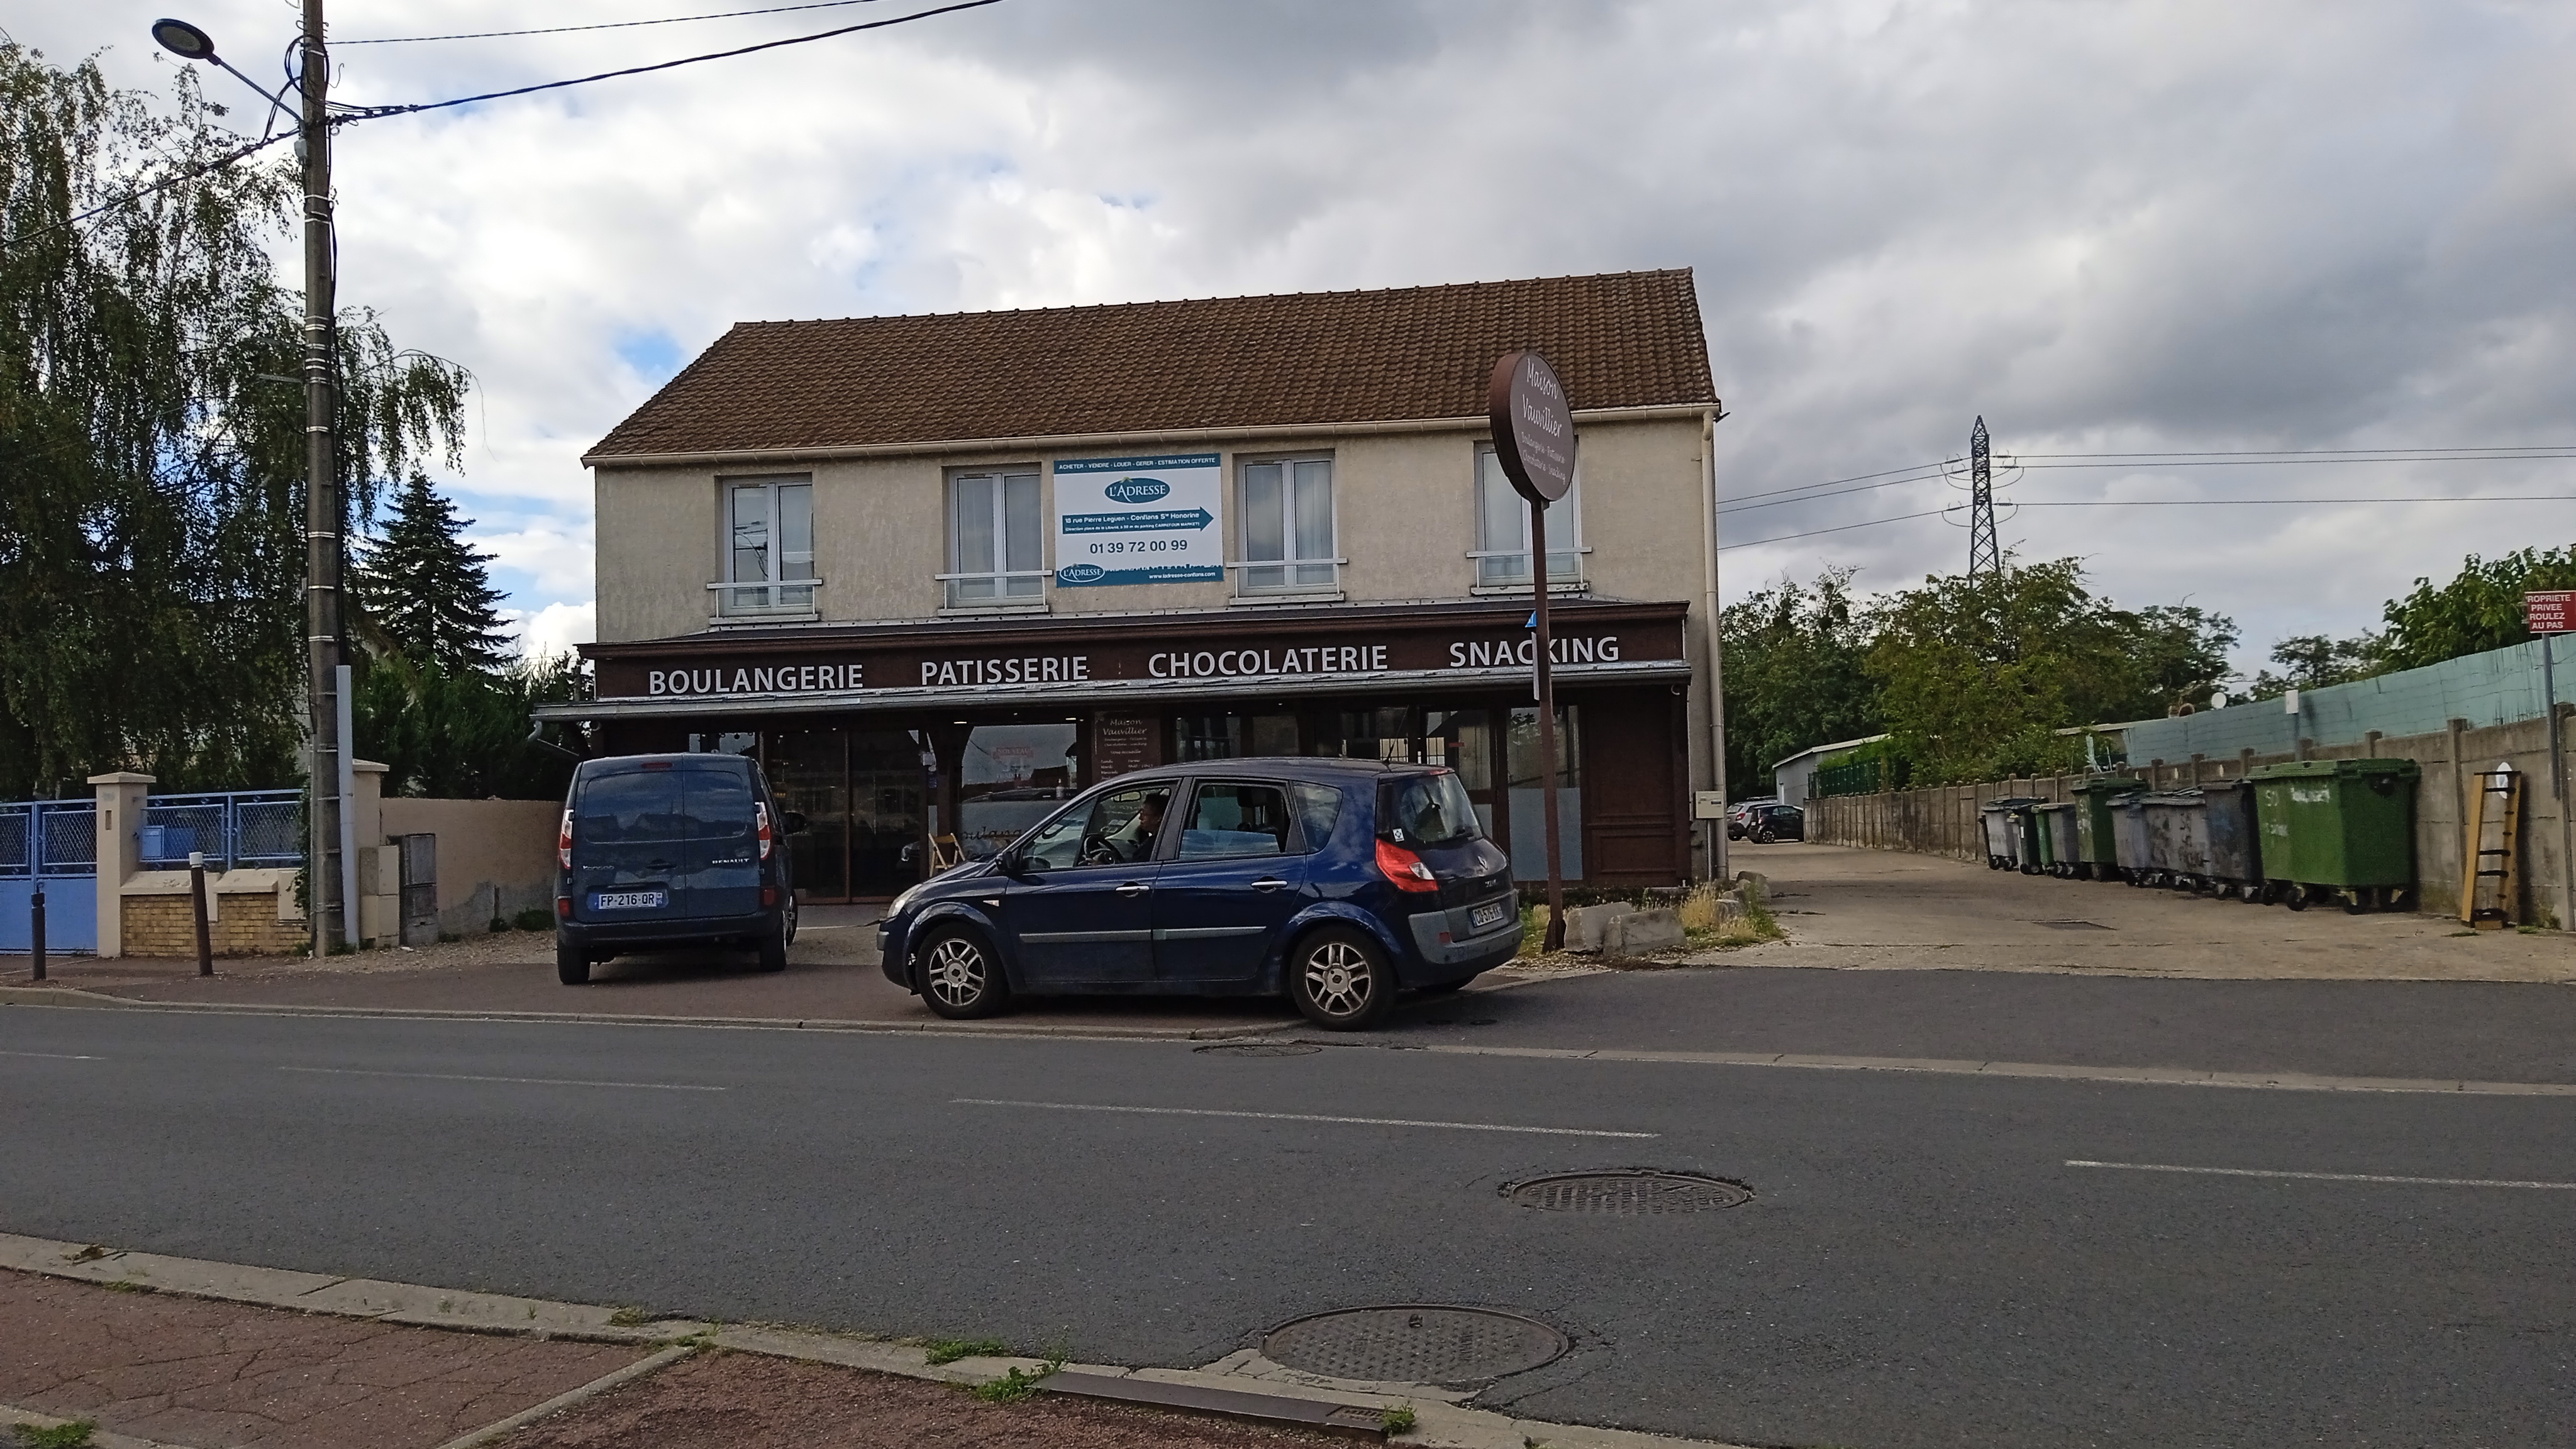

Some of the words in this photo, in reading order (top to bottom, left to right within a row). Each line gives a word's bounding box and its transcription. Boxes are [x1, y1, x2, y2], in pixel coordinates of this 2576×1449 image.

[1527, 358, 1558, 400] Maison
[1109, 484, 1165, 502] L'ADRESSE
[1090, 543, 1103, 553] 01
[1108, 542, 1124, 553] 39
[1129, 541, 1145, 552] 72
[1150, 541, 1167, 552] 00
[1171, 540, 1187, 550] 99
[1063, 569, 1101, 580] L'ADRESSE
[649, 665, 863, 694] BOULANGERIE
[921, 657, 1088, 686] PATISSERIE
[1148, 645, 1388, 678] CHOCOLATERIE
[1449, 636, 1620, 668] SNACKING
[601, 894, 655, 907] FP-216-QR
